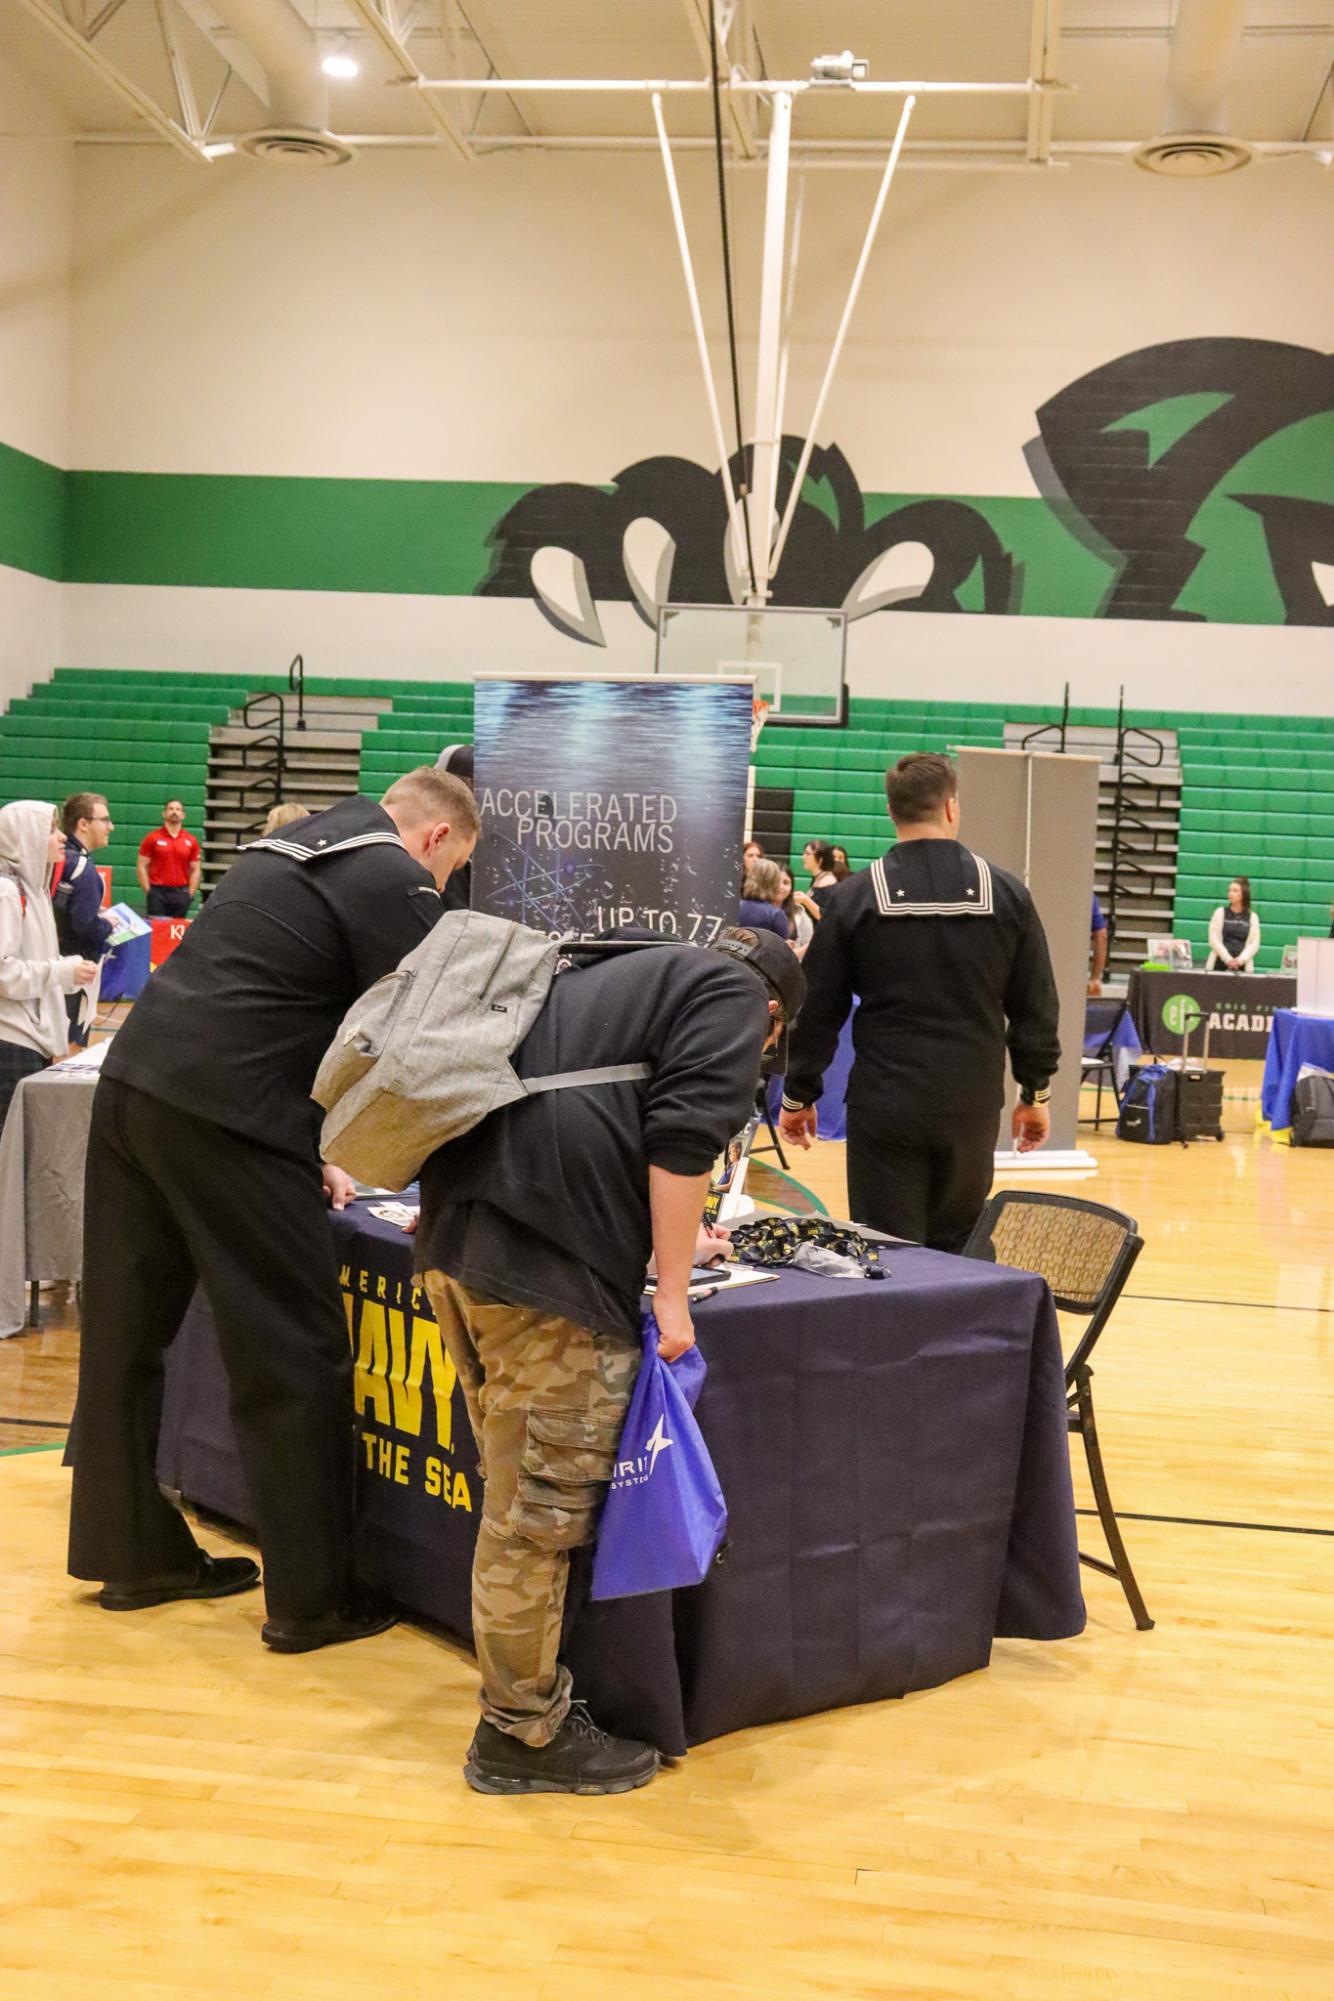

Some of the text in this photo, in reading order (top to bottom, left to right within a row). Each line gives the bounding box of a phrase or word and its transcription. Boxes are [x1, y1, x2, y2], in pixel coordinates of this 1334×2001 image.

[480, 788, 678, 824] ACCELERATED
[517, 817, 673, 853] PROGRAMS
[597, 906, 723, 948] UP TO 77
[341, 1291, 458, 1451] AVY
[362, 1432, 472, 1513] THE SEA
